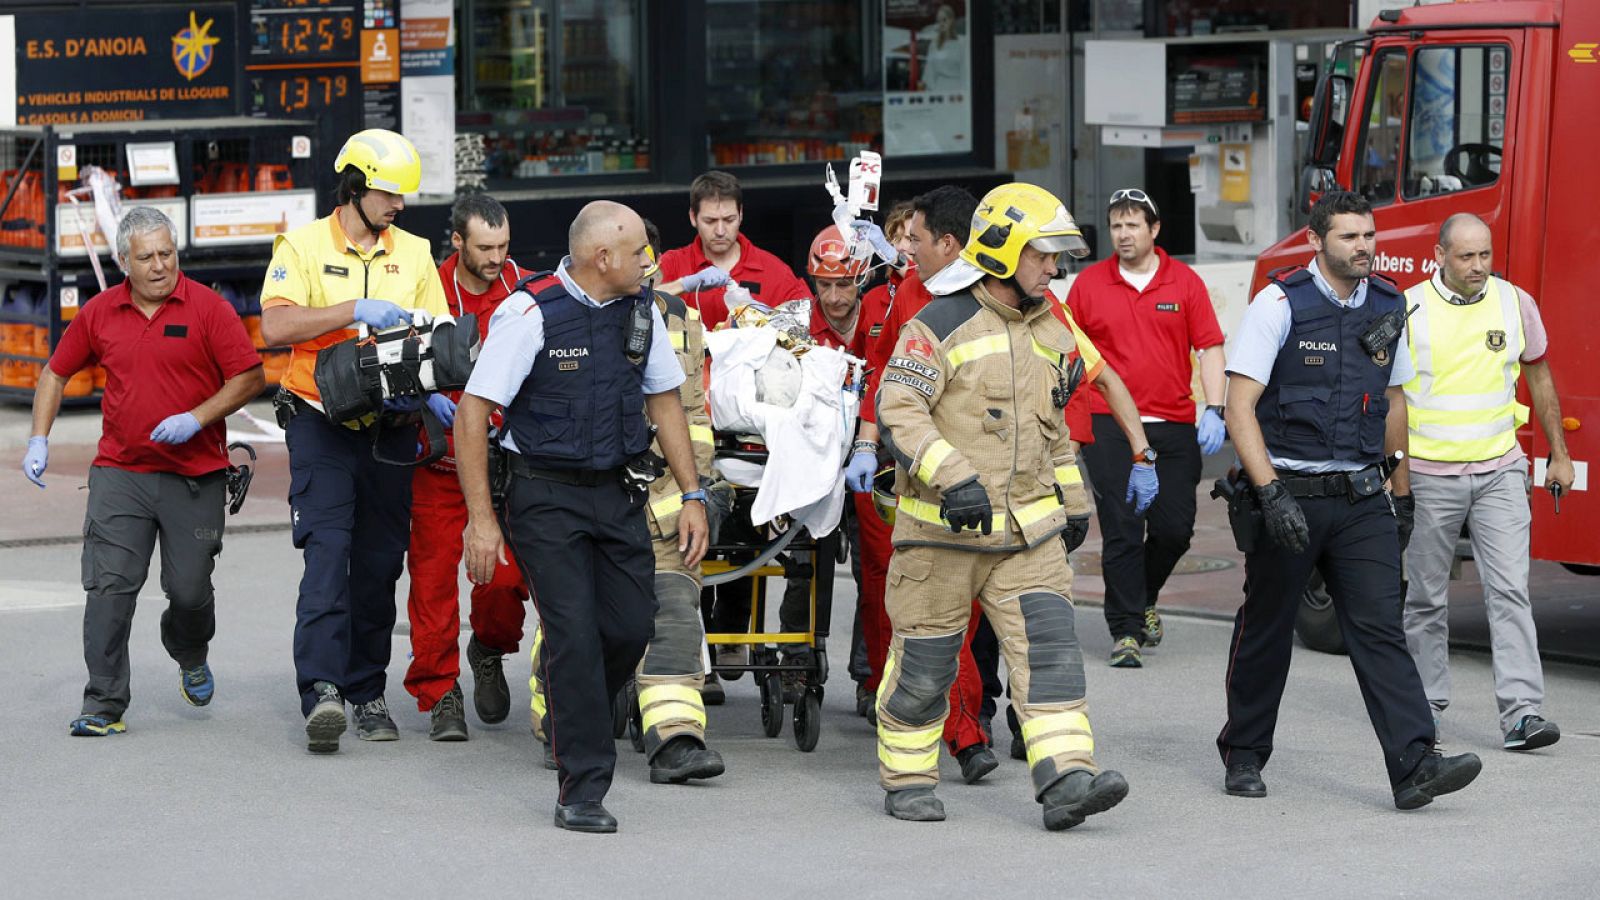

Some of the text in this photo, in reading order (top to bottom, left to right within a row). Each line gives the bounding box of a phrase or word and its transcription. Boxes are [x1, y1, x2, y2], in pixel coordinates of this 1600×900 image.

[26, 37, 147, 58] E.S. D'ANOIA
[28, 86, 229, 106] VEHICLES INDUSTRIALS DE LLOGUER
[28, 109, 144, 125] GASOILS A DOMICILI
[549, 347, 589, 358] POLICIA
[1298, 340, 1338, 353] POLICIA
[886, 373, 934, 394] BOMBER
